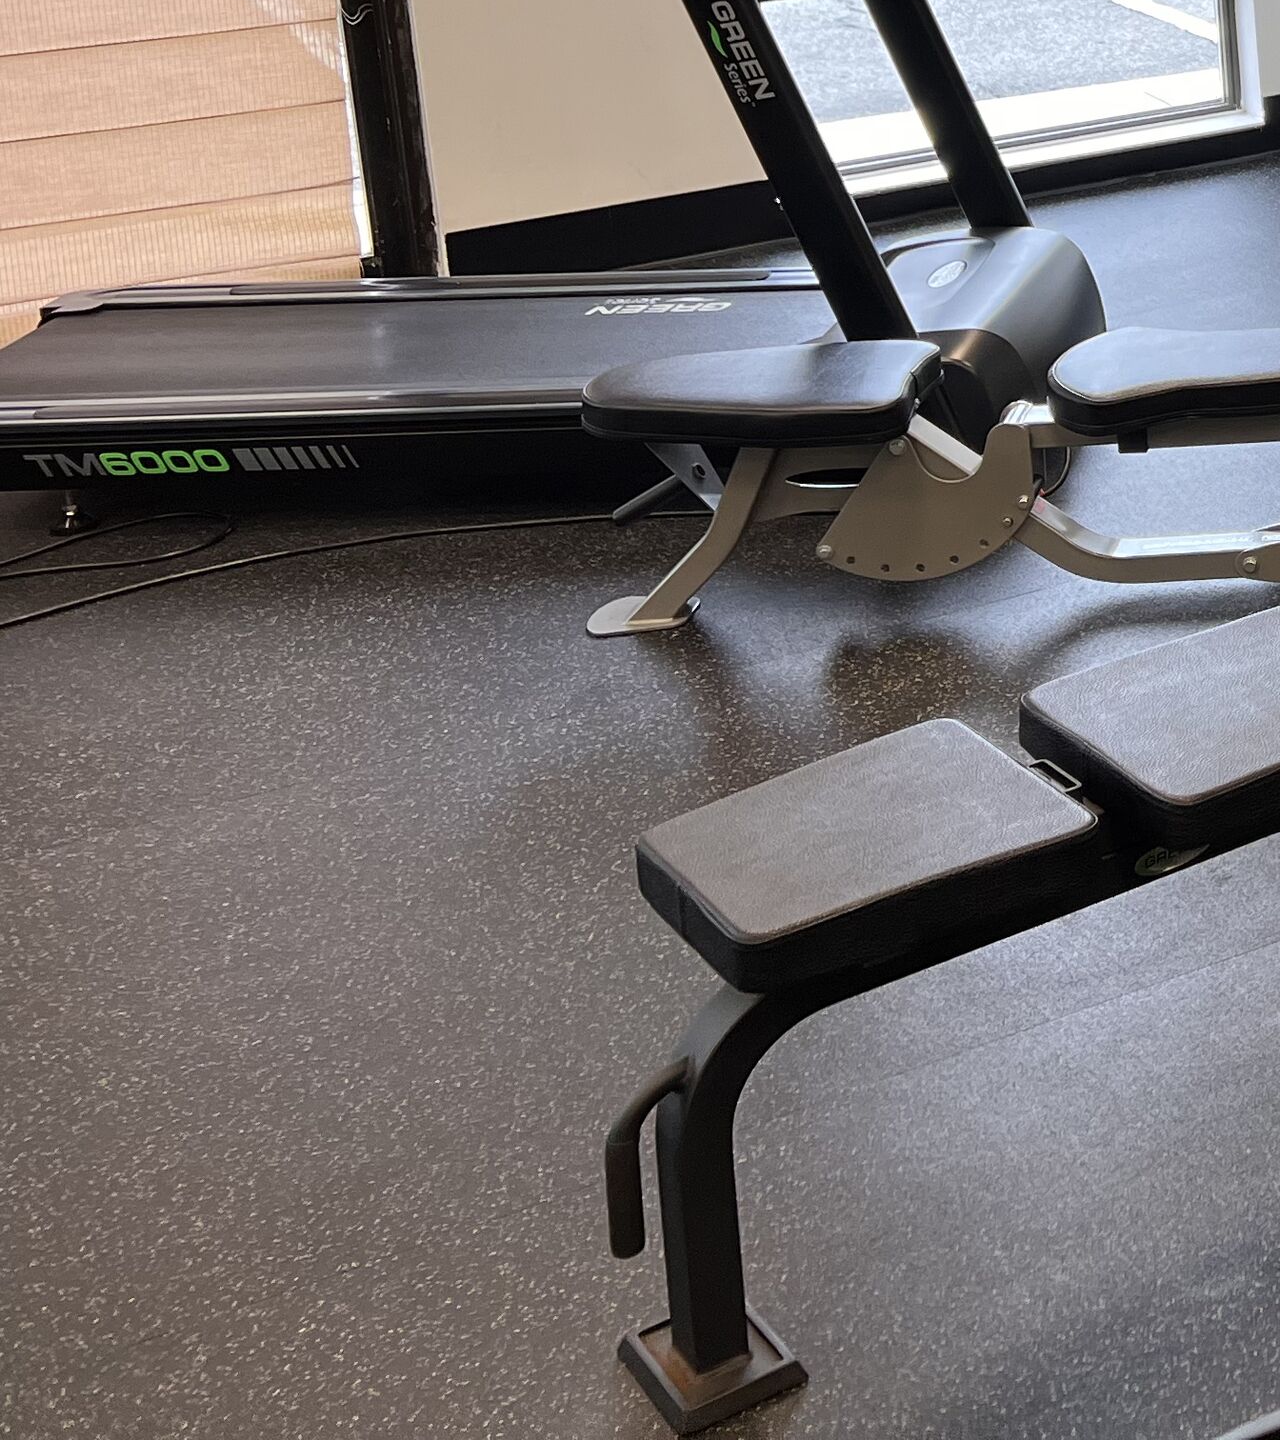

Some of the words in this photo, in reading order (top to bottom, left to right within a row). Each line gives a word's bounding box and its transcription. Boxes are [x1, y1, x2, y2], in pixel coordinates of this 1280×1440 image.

[711, 0, 776, 101] GREEN
[723, 62, 752, 105] Series
[584, 302, 732, 316] GREEN
[22, 448, 231, 478] TM6000
